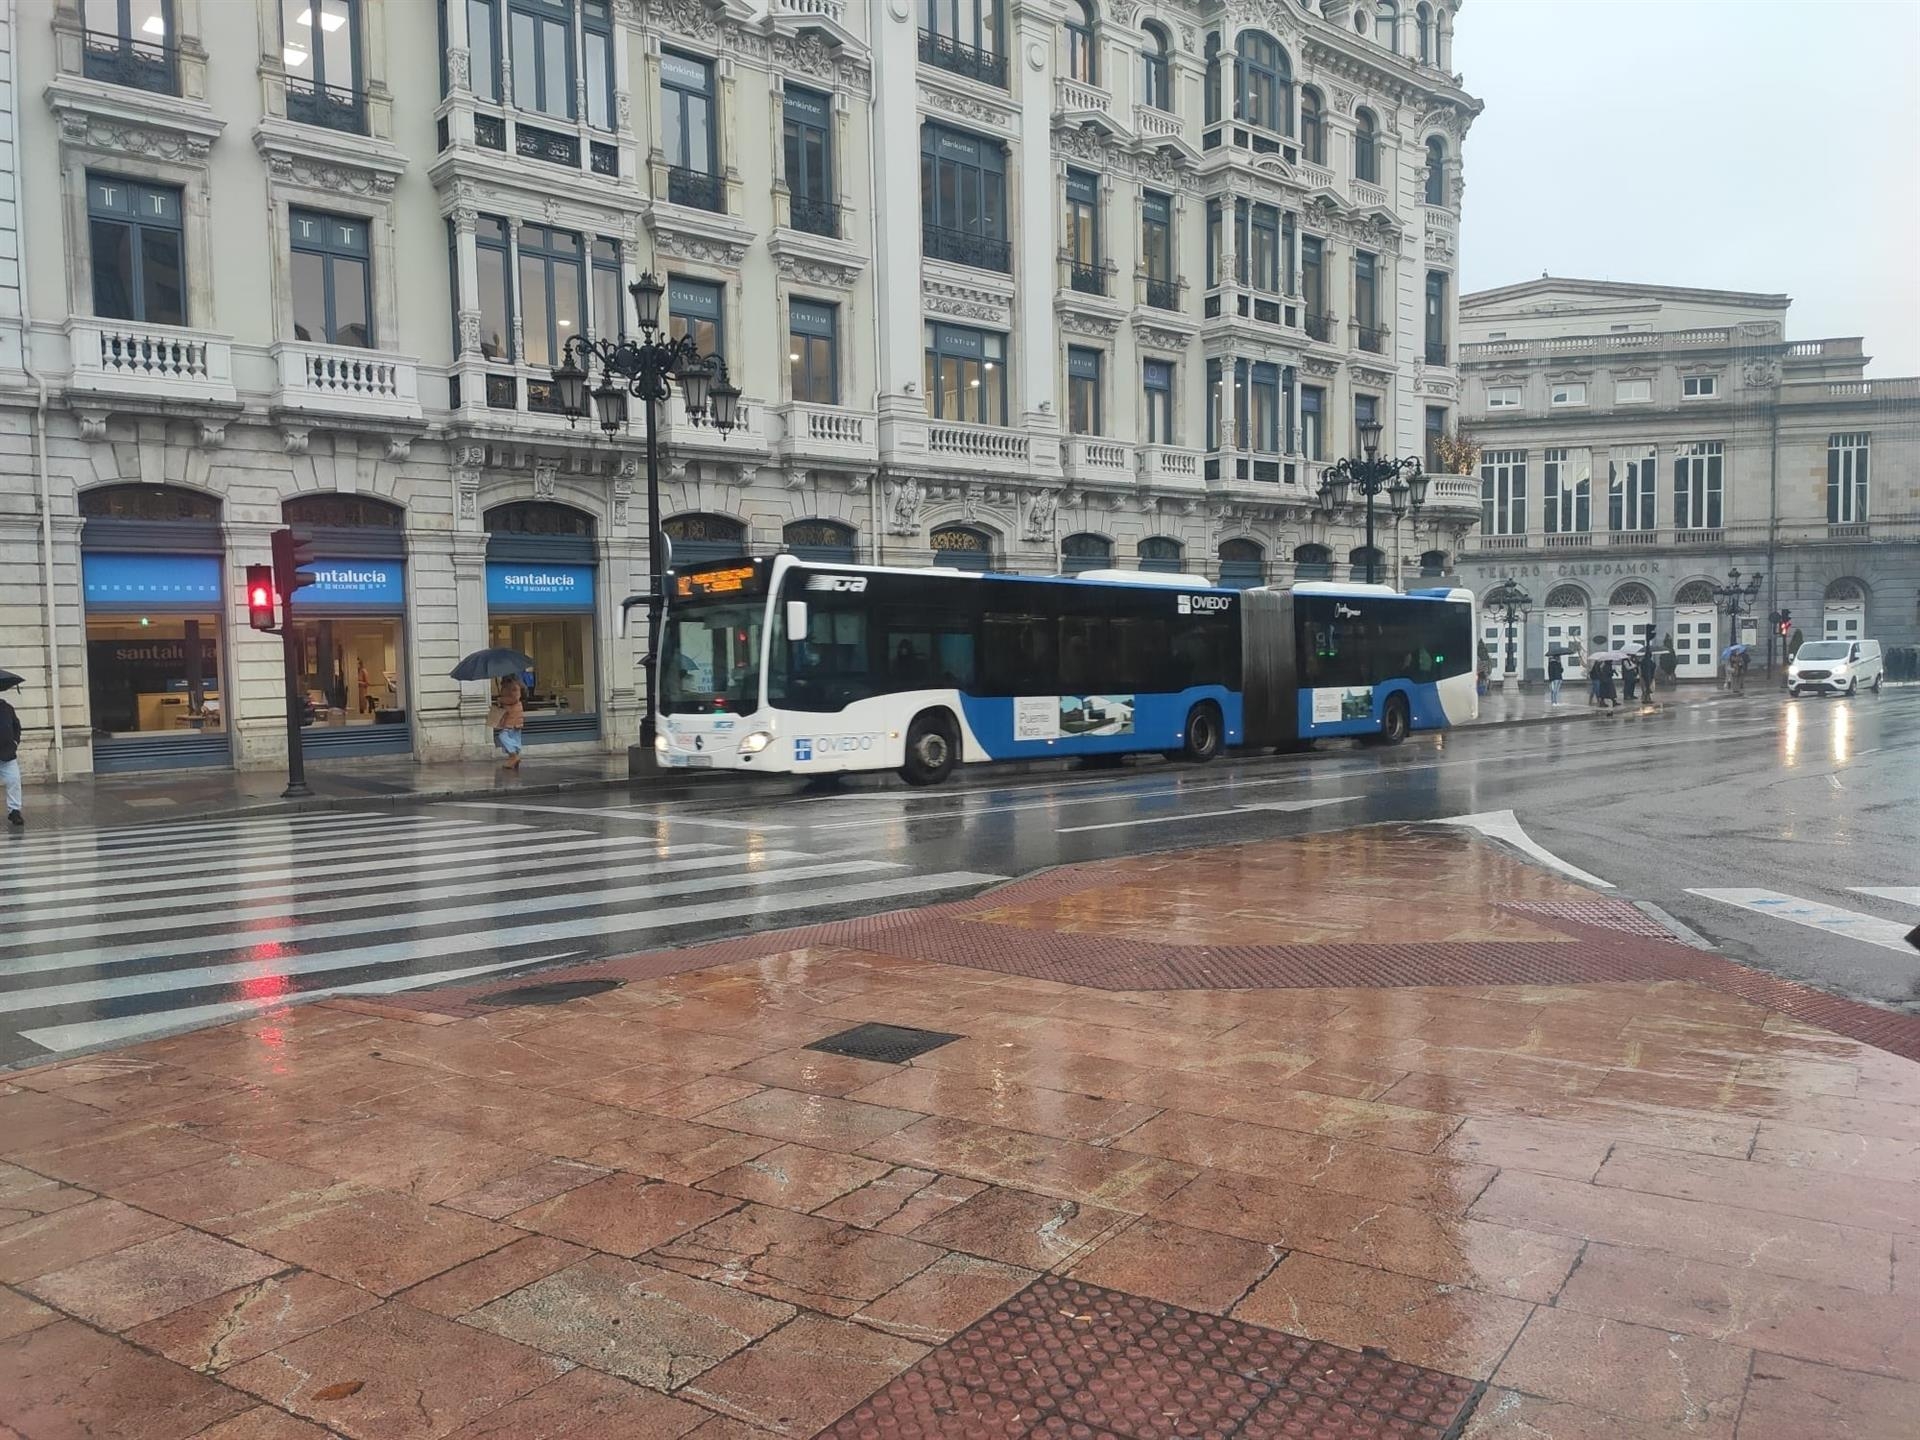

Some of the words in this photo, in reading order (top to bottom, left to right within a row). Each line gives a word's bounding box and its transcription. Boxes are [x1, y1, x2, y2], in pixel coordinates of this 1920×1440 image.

[671, 291, 712, 304] CENTIUM
[315, 569, 386, 583] antalucía
[1477, 567, 1541, 579] TEATRO
[1558, 562, 1661, 577] CAMPOAMOR
[1191, 595, 1229, 610] OVIEDO
[816, 735, 873, 753] OVIEDO
